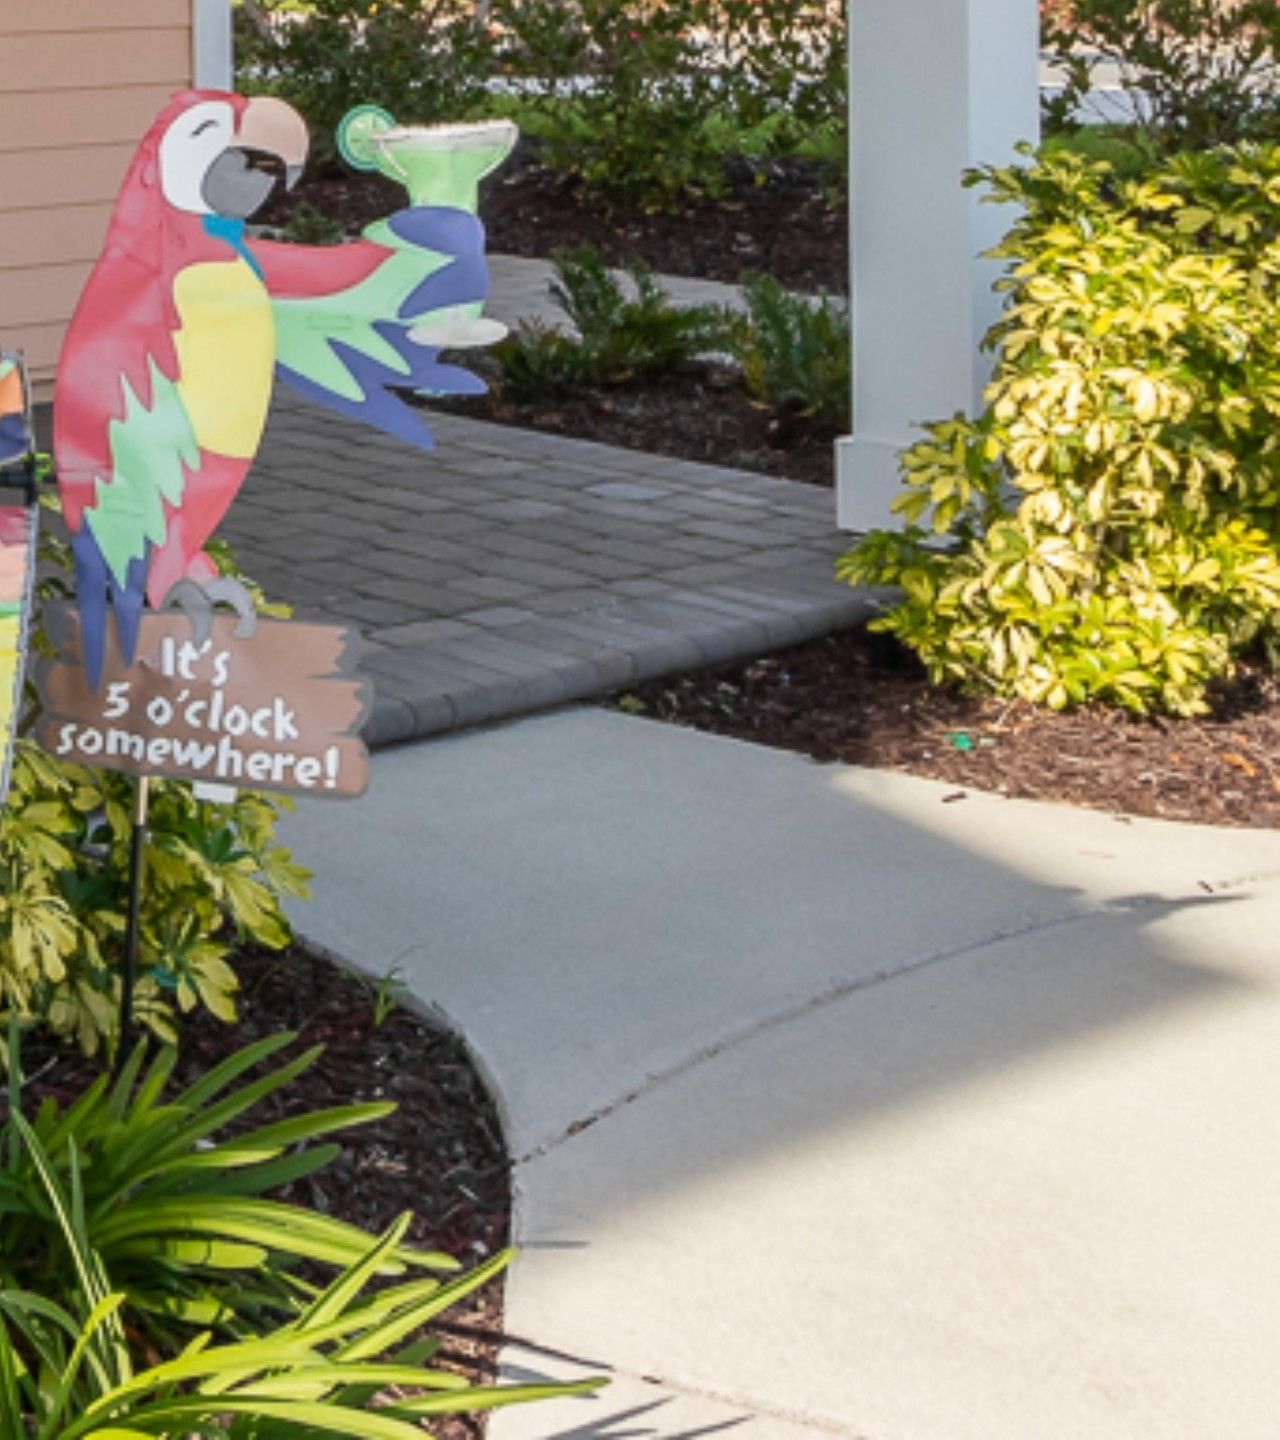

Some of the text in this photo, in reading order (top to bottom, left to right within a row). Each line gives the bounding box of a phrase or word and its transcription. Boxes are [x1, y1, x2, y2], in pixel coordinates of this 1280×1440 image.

[160, 636, 232, 688] It's
[102, 681, 300, 742] 5 o'clock
[55, 722, 341, 789] somewhere!
